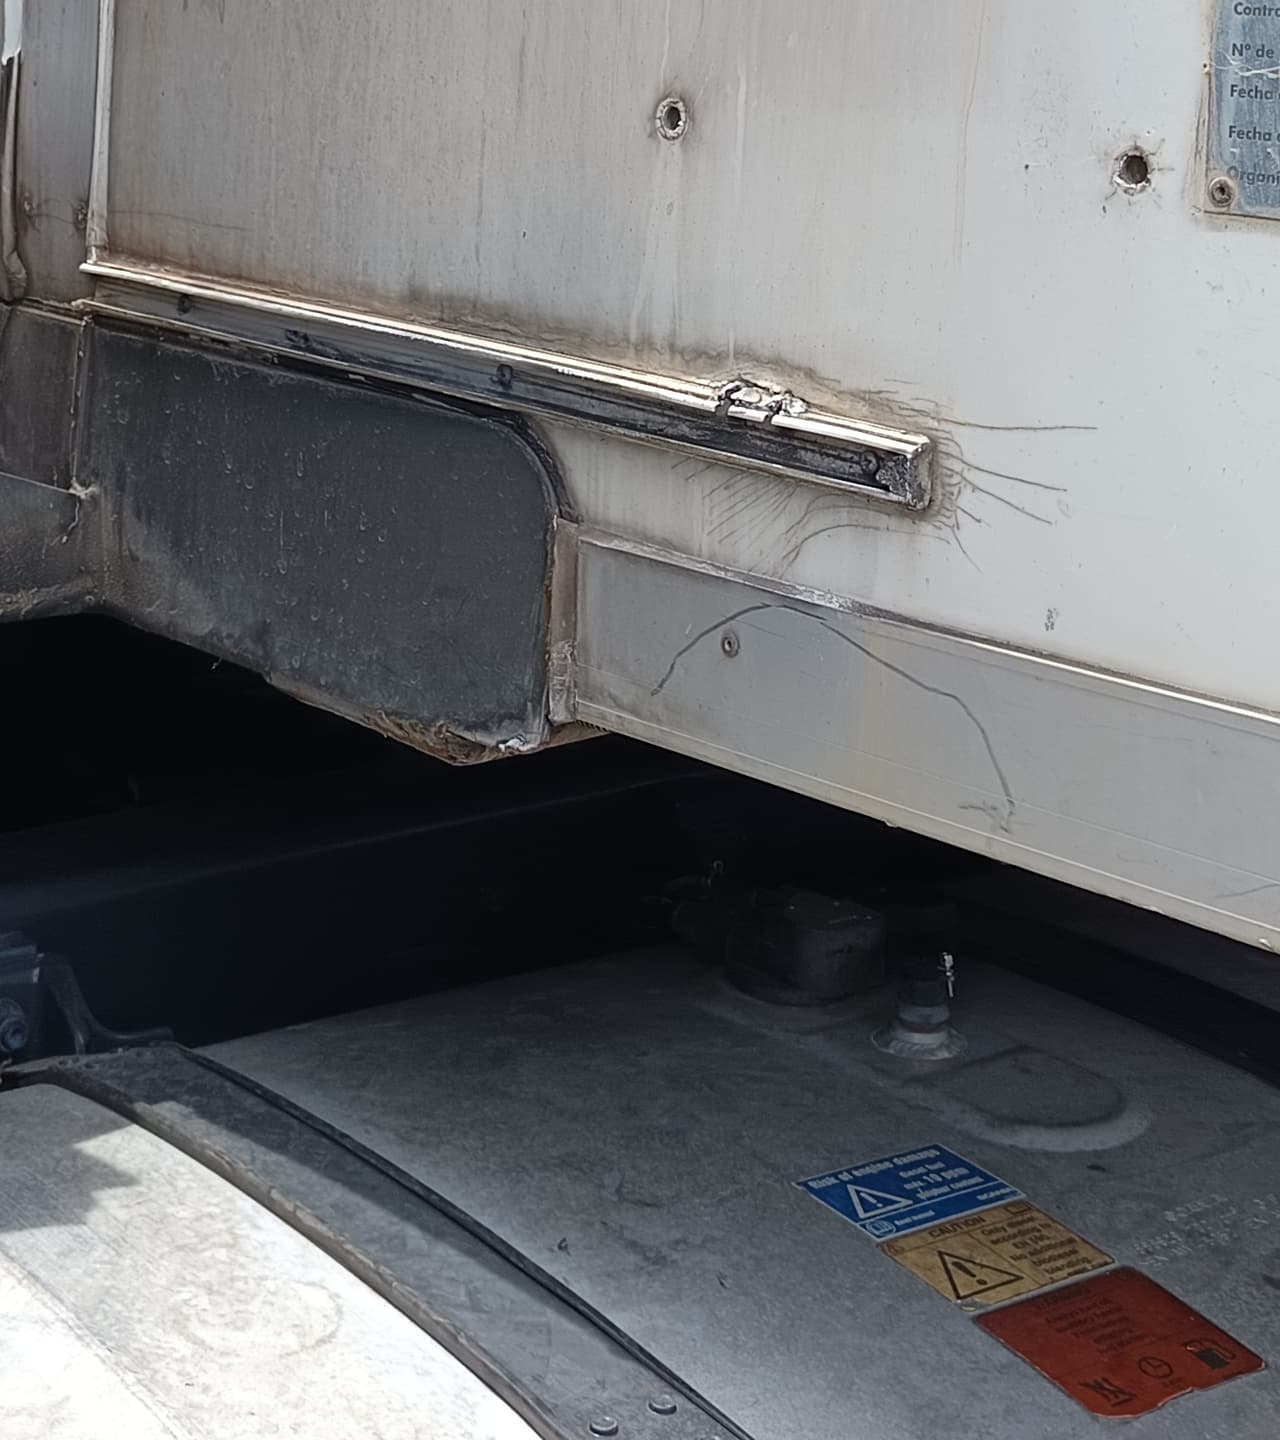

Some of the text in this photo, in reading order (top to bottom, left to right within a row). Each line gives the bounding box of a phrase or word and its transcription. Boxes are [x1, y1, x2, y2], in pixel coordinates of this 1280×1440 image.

[1255, 44, 1275, 59] de
[1230, 84, 1273, 100] Fecha
[1228, 125, 1272, 141] Fecha
[808, 1149, 941, 1190] Risk of engine damage
[923, 1172, 943, 1184] 10
[928, 1215, 987, 1238] CAUTION
[981, 1224, 1008, 1237] Only
